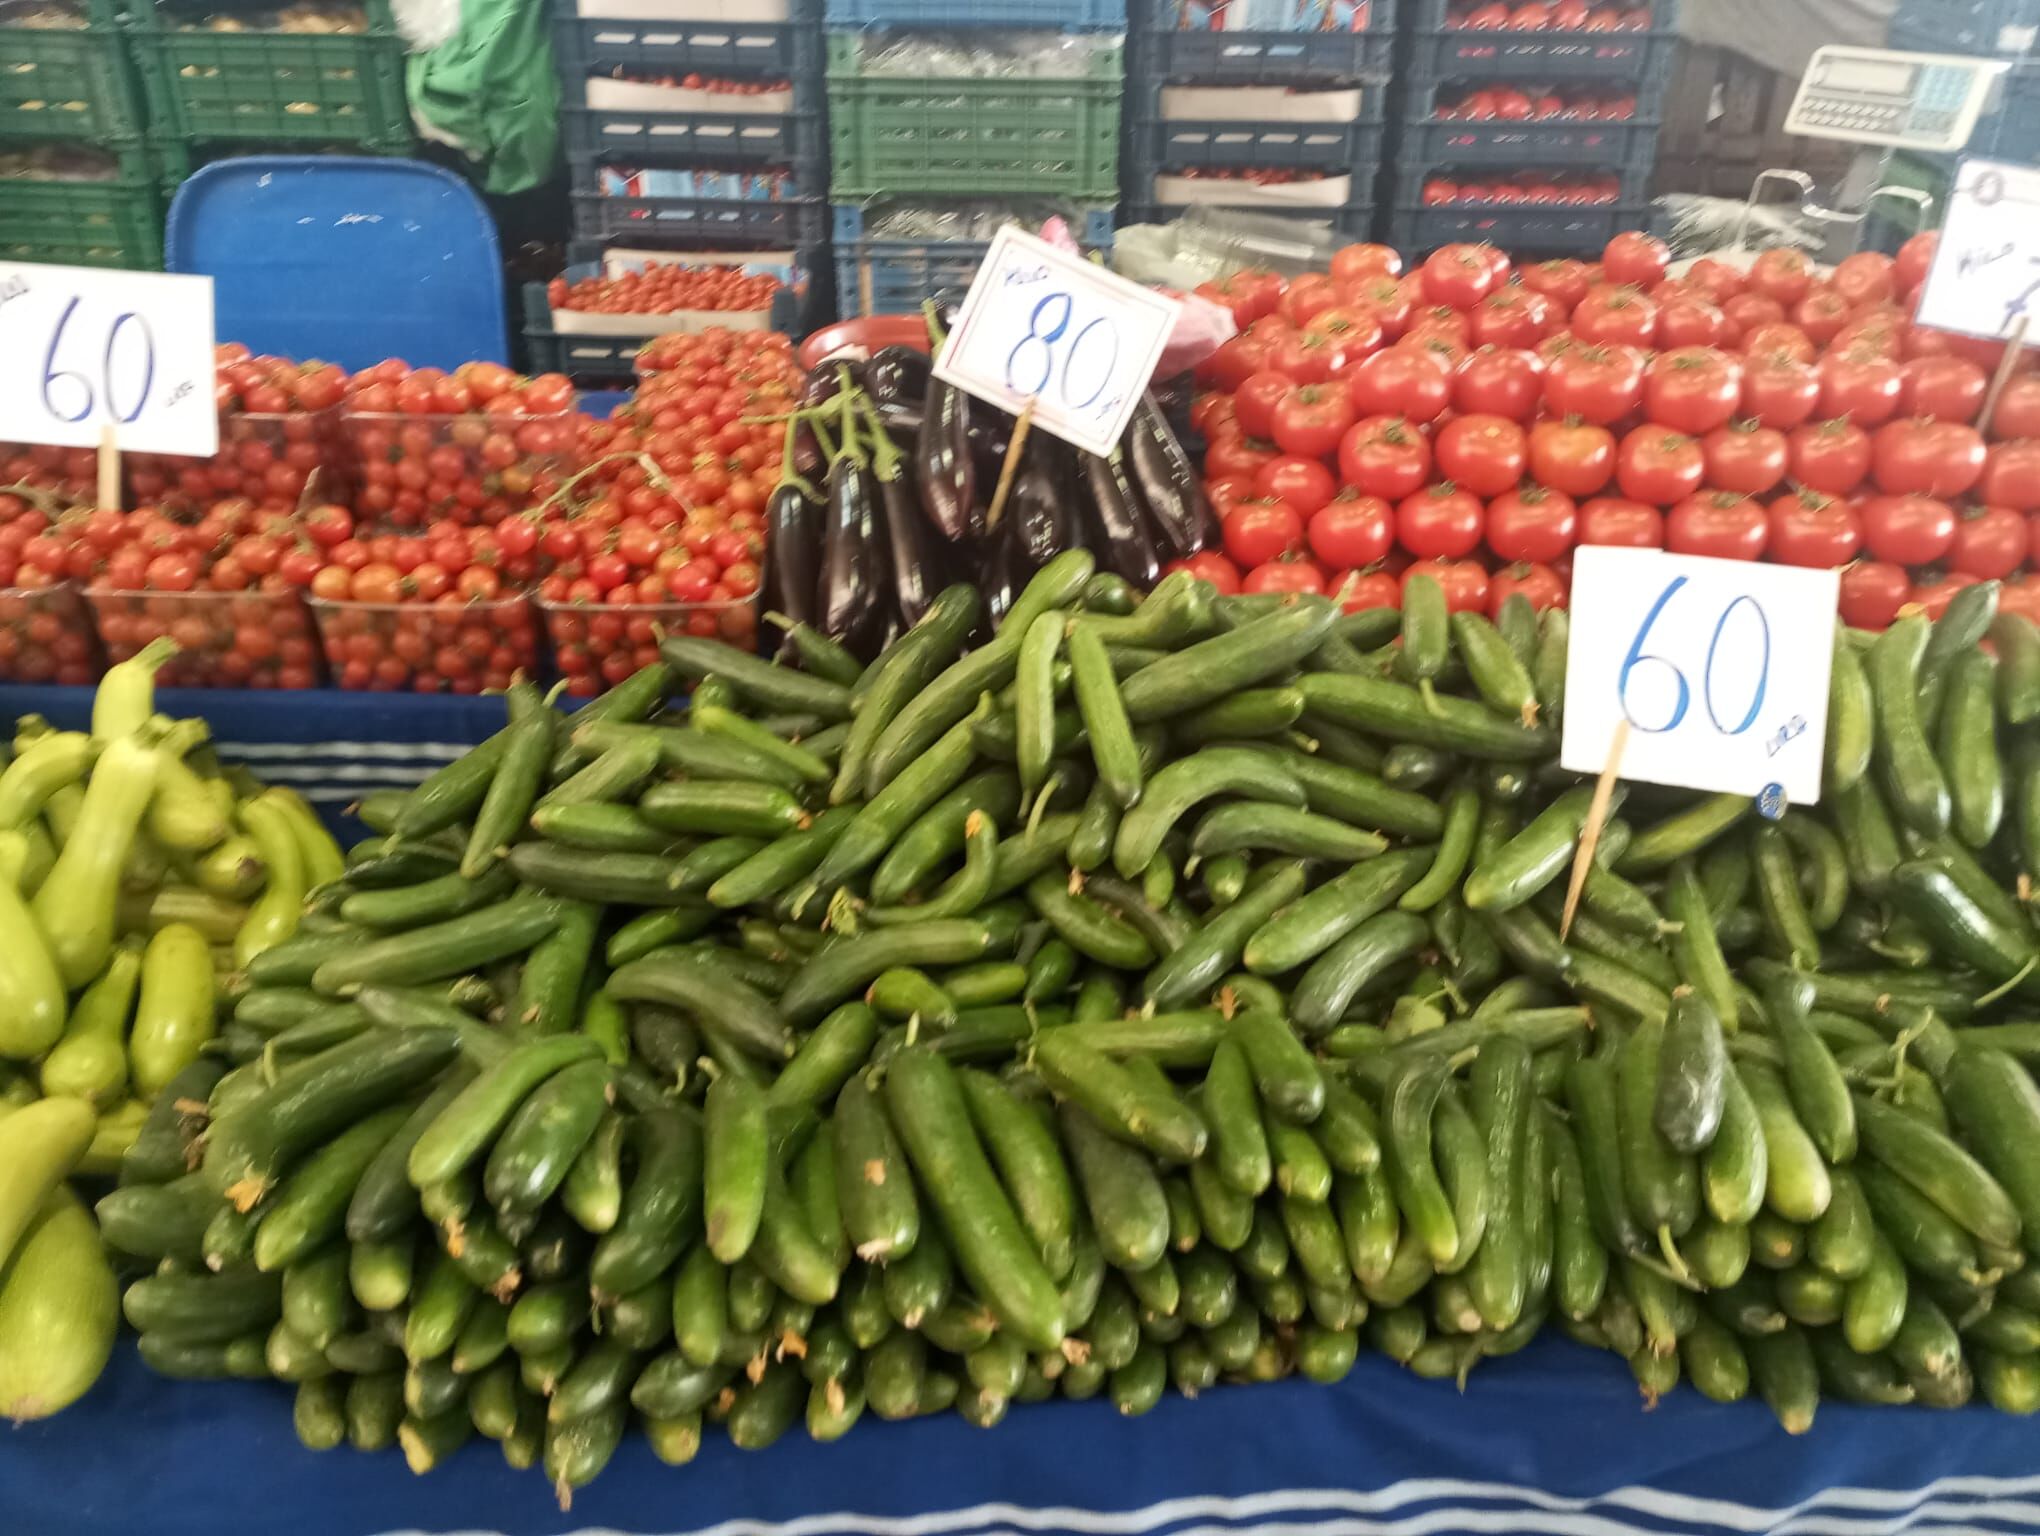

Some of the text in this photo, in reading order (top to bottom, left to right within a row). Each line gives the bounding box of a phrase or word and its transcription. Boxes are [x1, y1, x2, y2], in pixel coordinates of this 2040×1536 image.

[40, 295, 156, 423] 60
[1005, 291, 1120, 410] 80
[1617, 574, 1771, 735] 60
